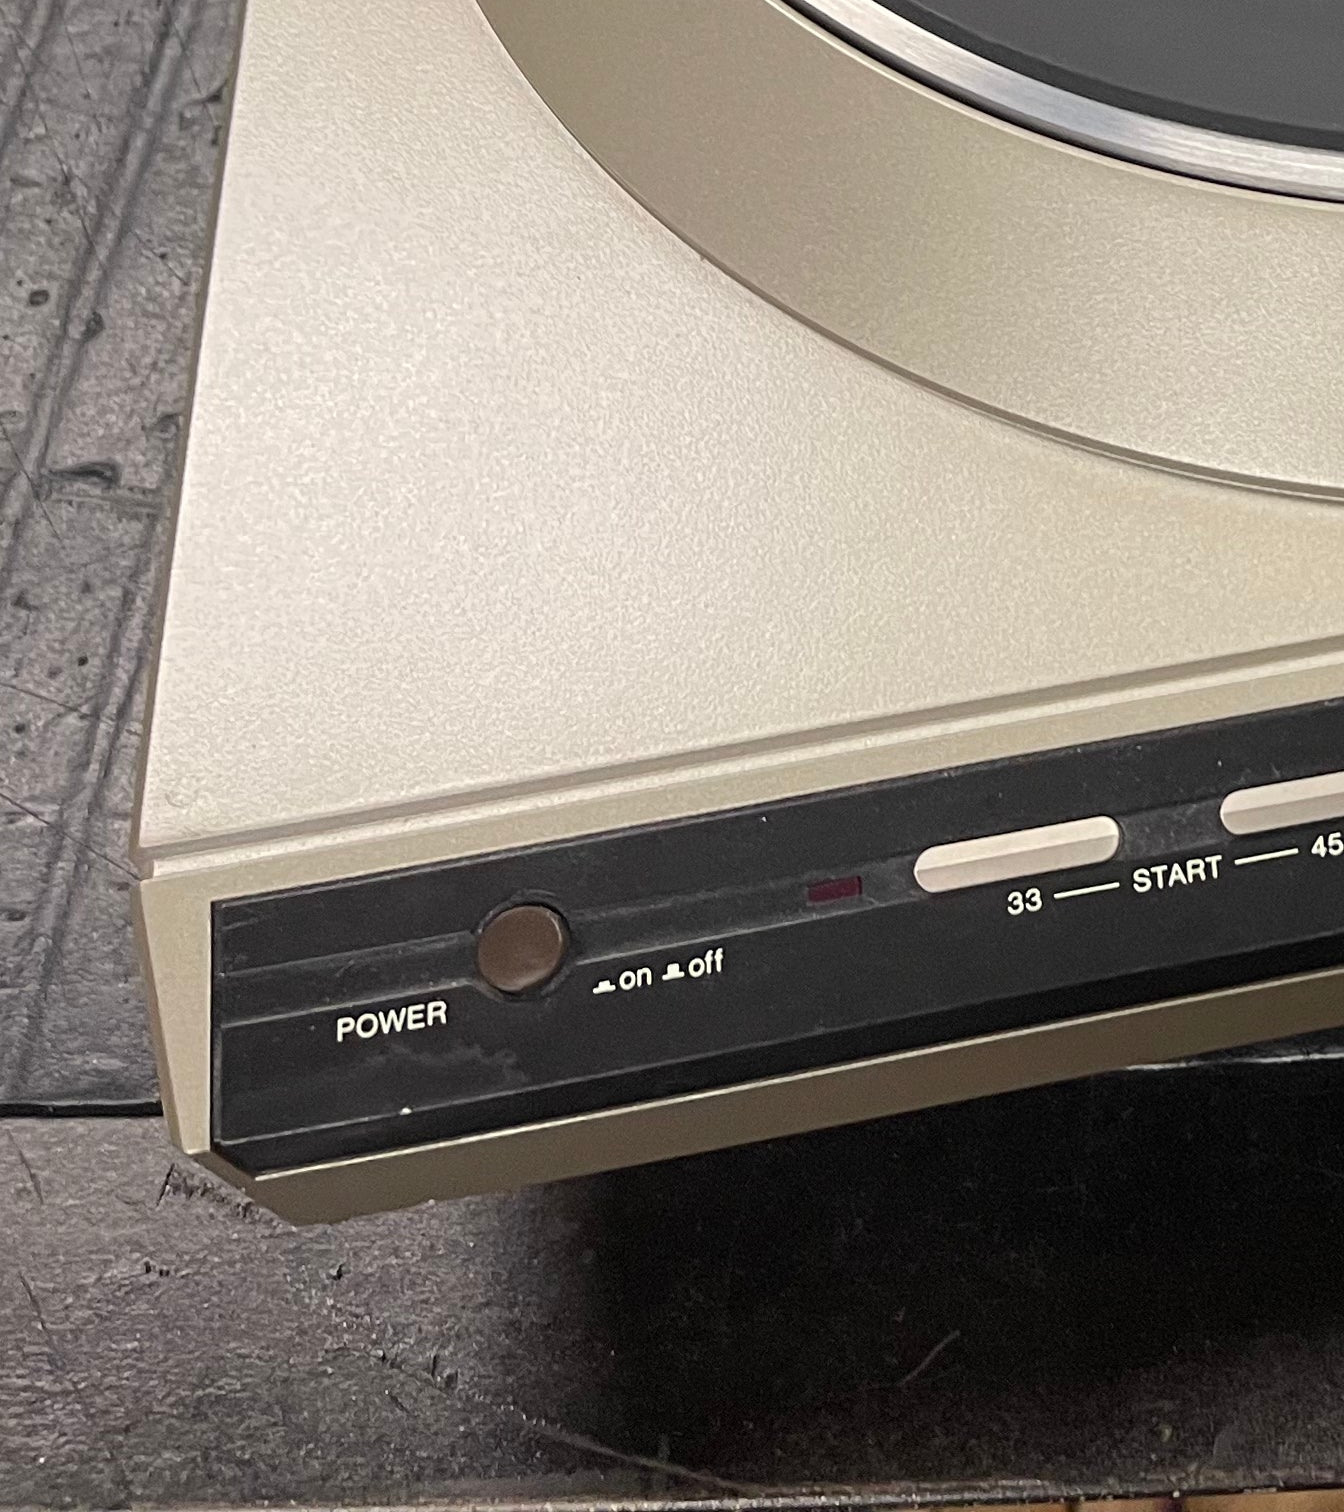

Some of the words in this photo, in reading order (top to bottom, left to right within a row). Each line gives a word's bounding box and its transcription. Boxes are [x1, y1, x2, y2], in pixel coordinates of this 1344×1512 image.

[1007, 887, 1043, 916] 33
[1132, 854, 1223, 894] START
[1310, 831, 1344, 859] 45
[335, 999, 448, 1043] POWER
[618, 965, 653, 991] on
[688, 947, 724, 977] off
